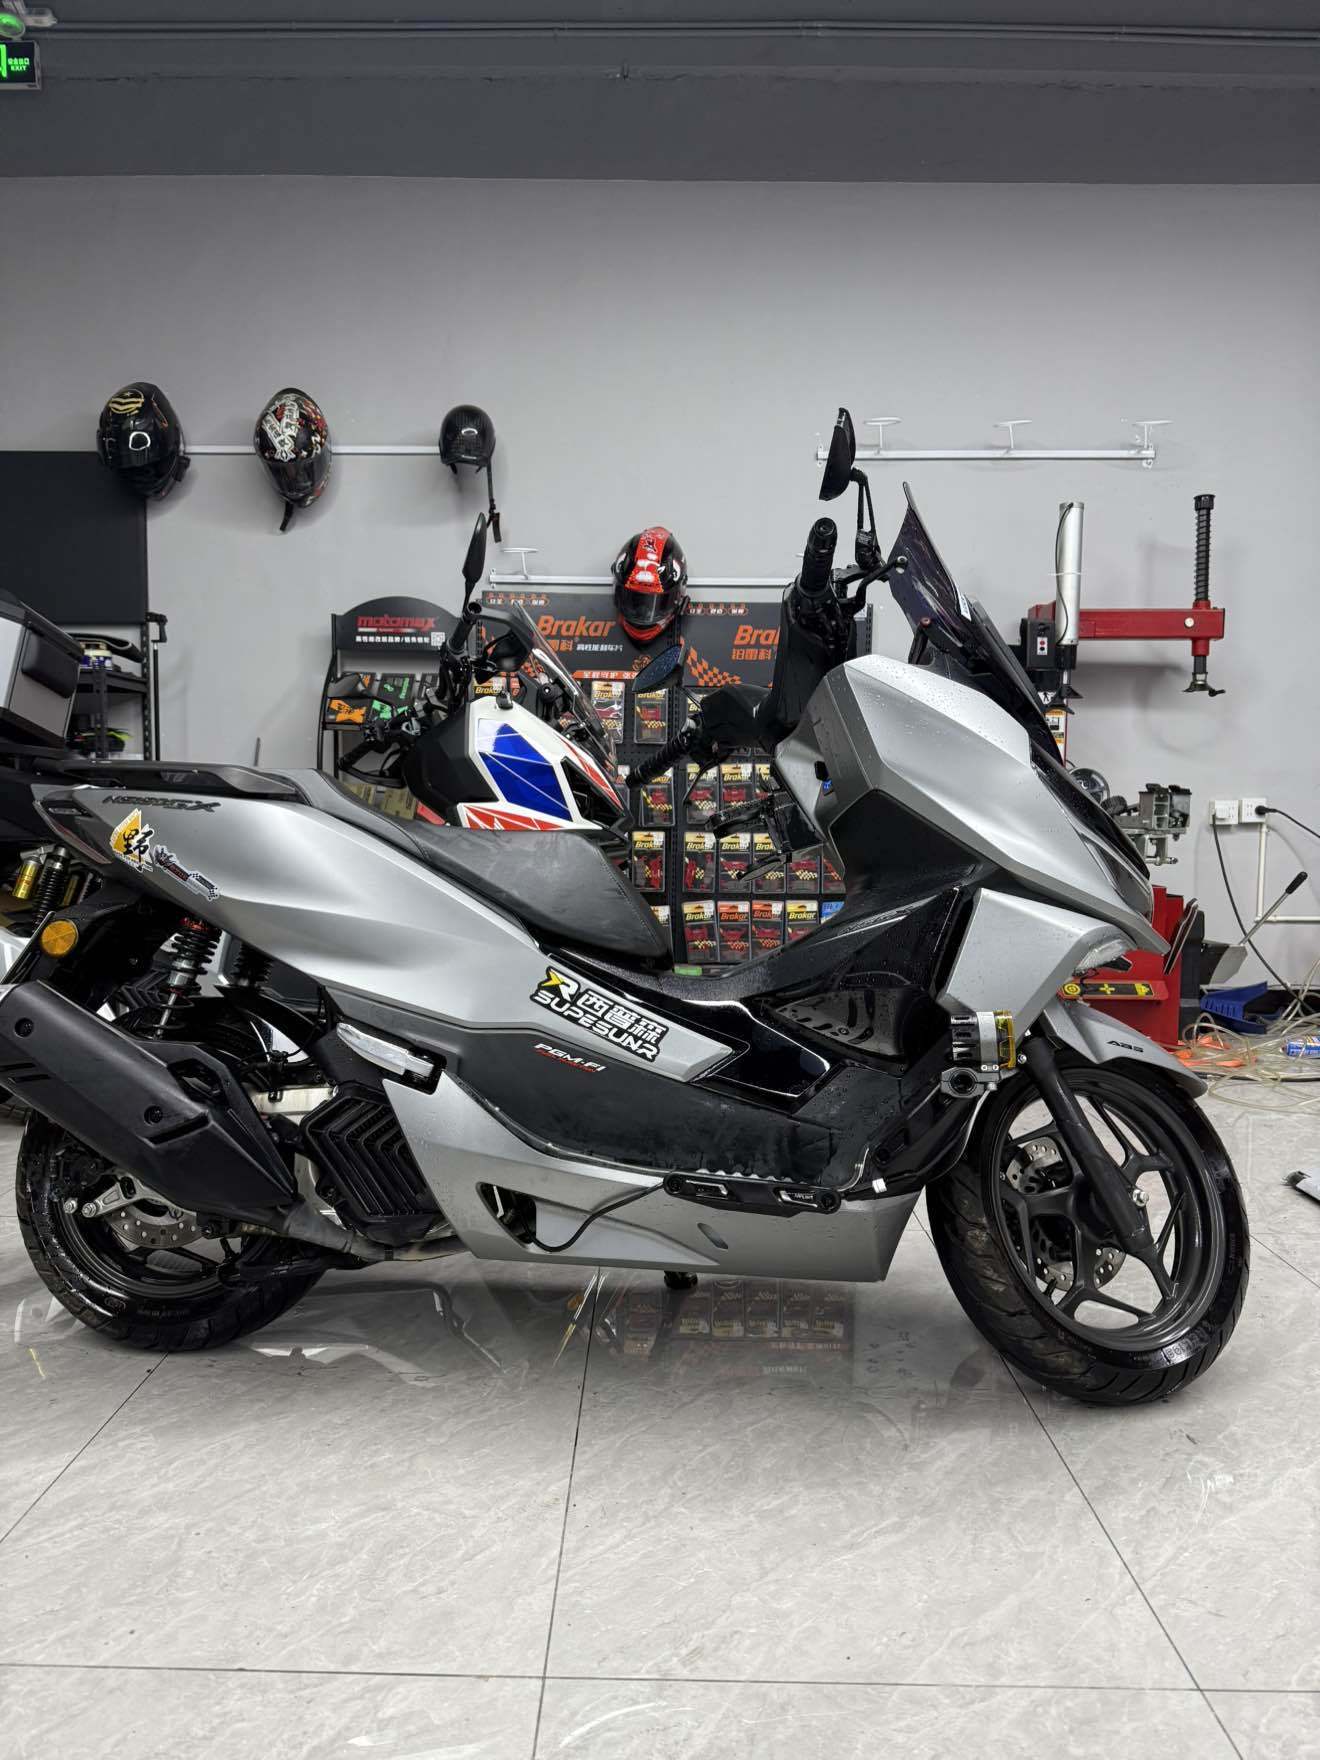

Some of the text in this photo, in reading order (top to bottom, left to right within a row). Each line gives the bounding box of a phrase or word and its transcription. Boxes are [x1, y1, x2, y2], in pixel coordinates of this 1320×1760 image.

[537, 615, 616, 637] Brakar
[734, 625, 780, 645] Bra
[789, 911, 816, 920] Brakar
[534, 990, 659, 1060] SUPESUNR
[576, 990, 667, 1044] 西普森
[533, 1043, 607, 1072] PGM-FI
[1106, 1040, 1144, 1053] ABS
